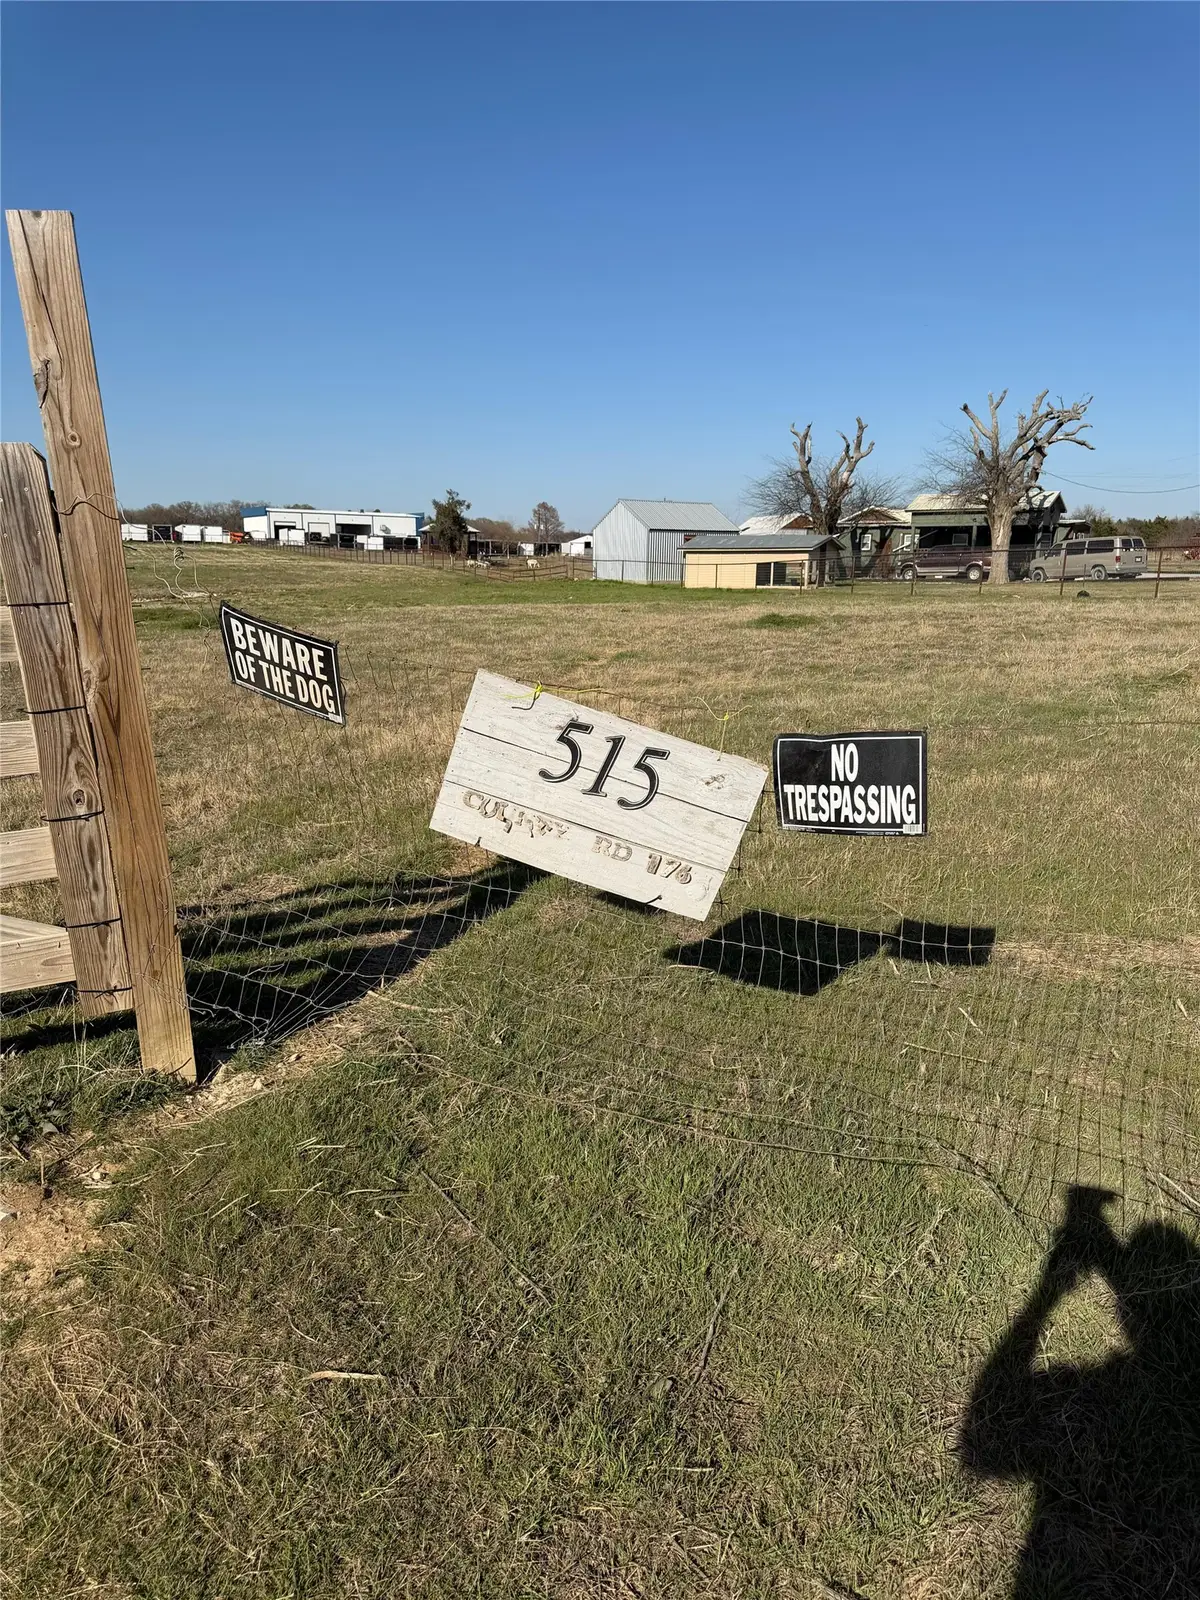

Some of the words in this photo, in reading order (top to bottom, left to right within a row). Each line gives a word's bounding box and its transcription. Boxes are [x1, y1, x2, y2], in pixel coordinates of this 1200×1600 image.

[230, 617, 328, 681] BEWARE
[234, 650, 256, 682] OF
[258, 659, 295, 698] THE
[295, 674, 336, 713] DOG
[538, 719, 670, 811] 515
[831, 742, 859, 782] NO
[783, 784, 916, 824] TRESPASSING
[591, 835, 633, 862] RD
[646, 852, 692, 884] 176
